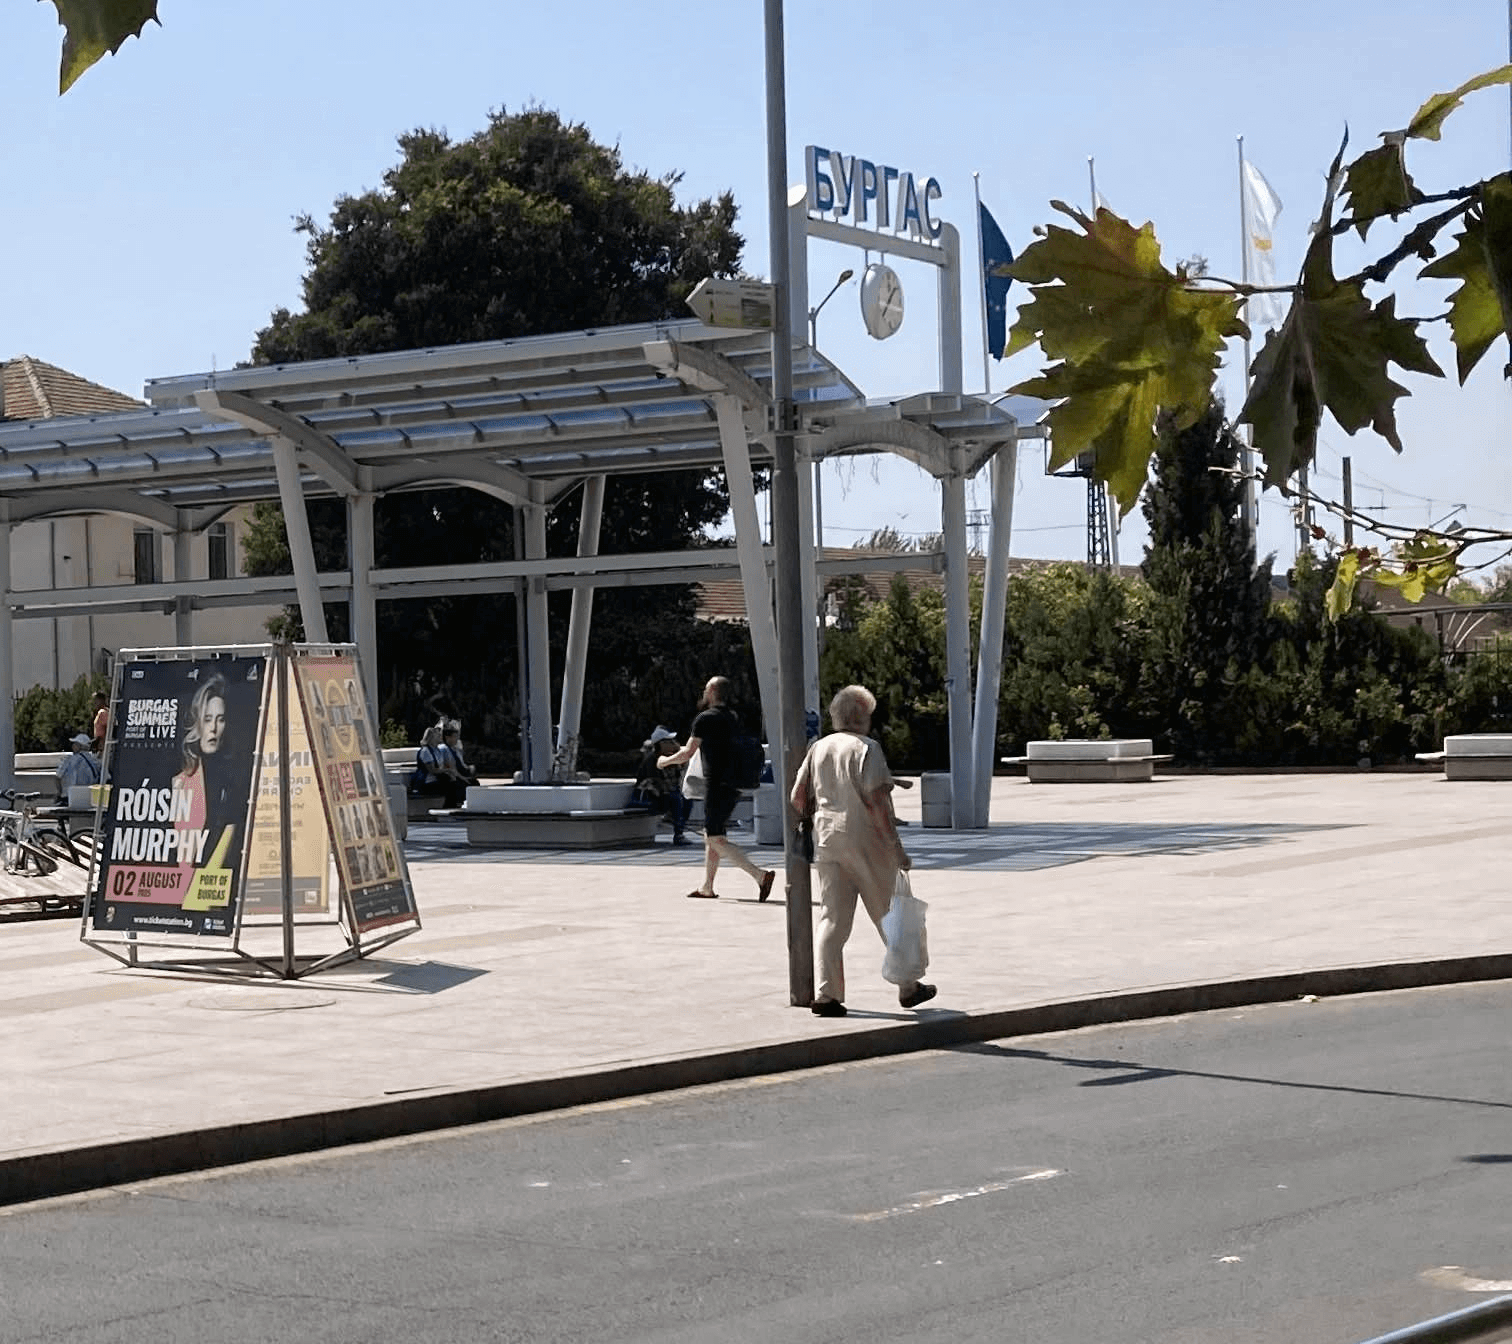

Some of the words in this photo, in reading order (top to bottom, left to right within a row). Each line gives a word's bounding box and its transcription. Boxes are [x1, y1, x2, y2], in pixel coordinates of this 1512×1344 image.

[805, 145, 943, 240] БУРГАС
[128, 699, 178, 713] BURGAS
[127, 712, 177, 726] SUMMER
[149, 726, 176, 738] LIVE
[116, 778, 193, 823] RÓISIN
[110, 827, 210, 864] MURPHY
[113, 870, 137, 896] 02
[139, 871, 183, 889] AUGUST
[199, 874, 218, 886] PORT
[219, 875, 229, 887] OF
[197, 889, 226, 901] BURGAS
